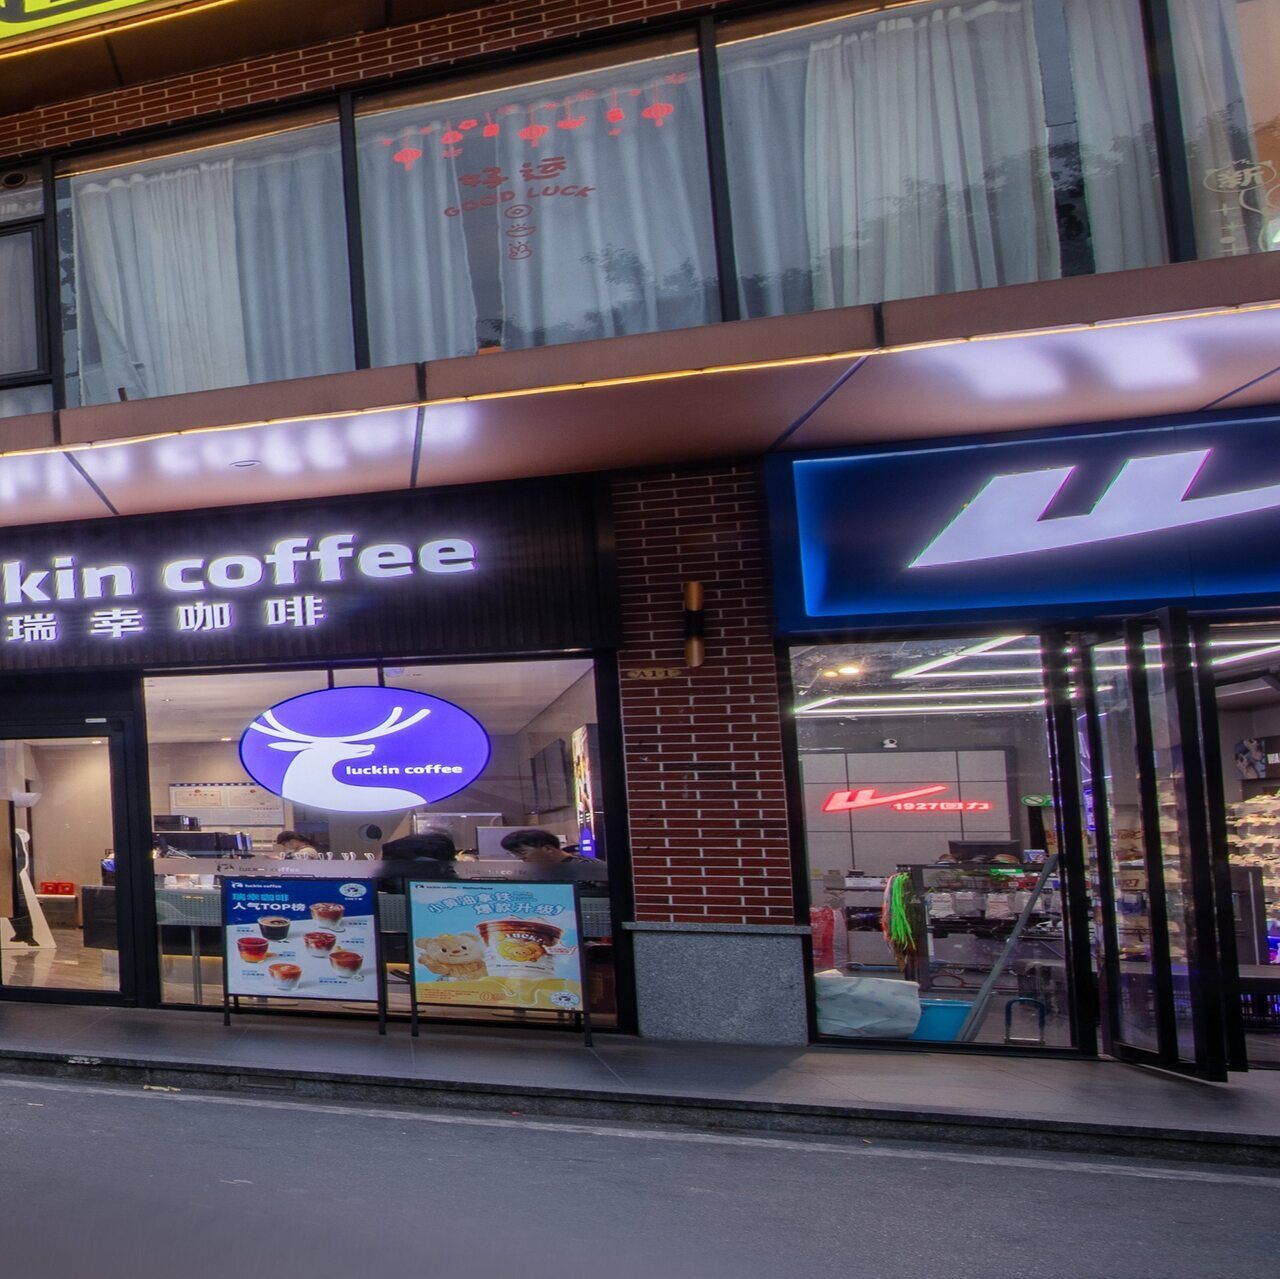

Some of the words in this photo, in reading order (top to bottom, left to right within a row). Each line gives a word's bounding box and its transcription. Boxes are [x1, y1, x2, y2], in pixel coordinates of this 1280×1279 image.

[458, 156, 567, 189] 好运
[444, 190, 516, 218] GOOD
[526, 184, 596, 199] LUCK
[161, 532, 478, 593] coffee
[7, 594, 325, 643] 瑞幸咖啡
[345, 763, 400, 775] luckin
[403, 762, 464, 775] coffee
[892, 801, 991, 811] 1927回力
[232, 893, 289, 902] 瑞幸咖啡
[232, 901, 307, 912] 人气TOP榜
